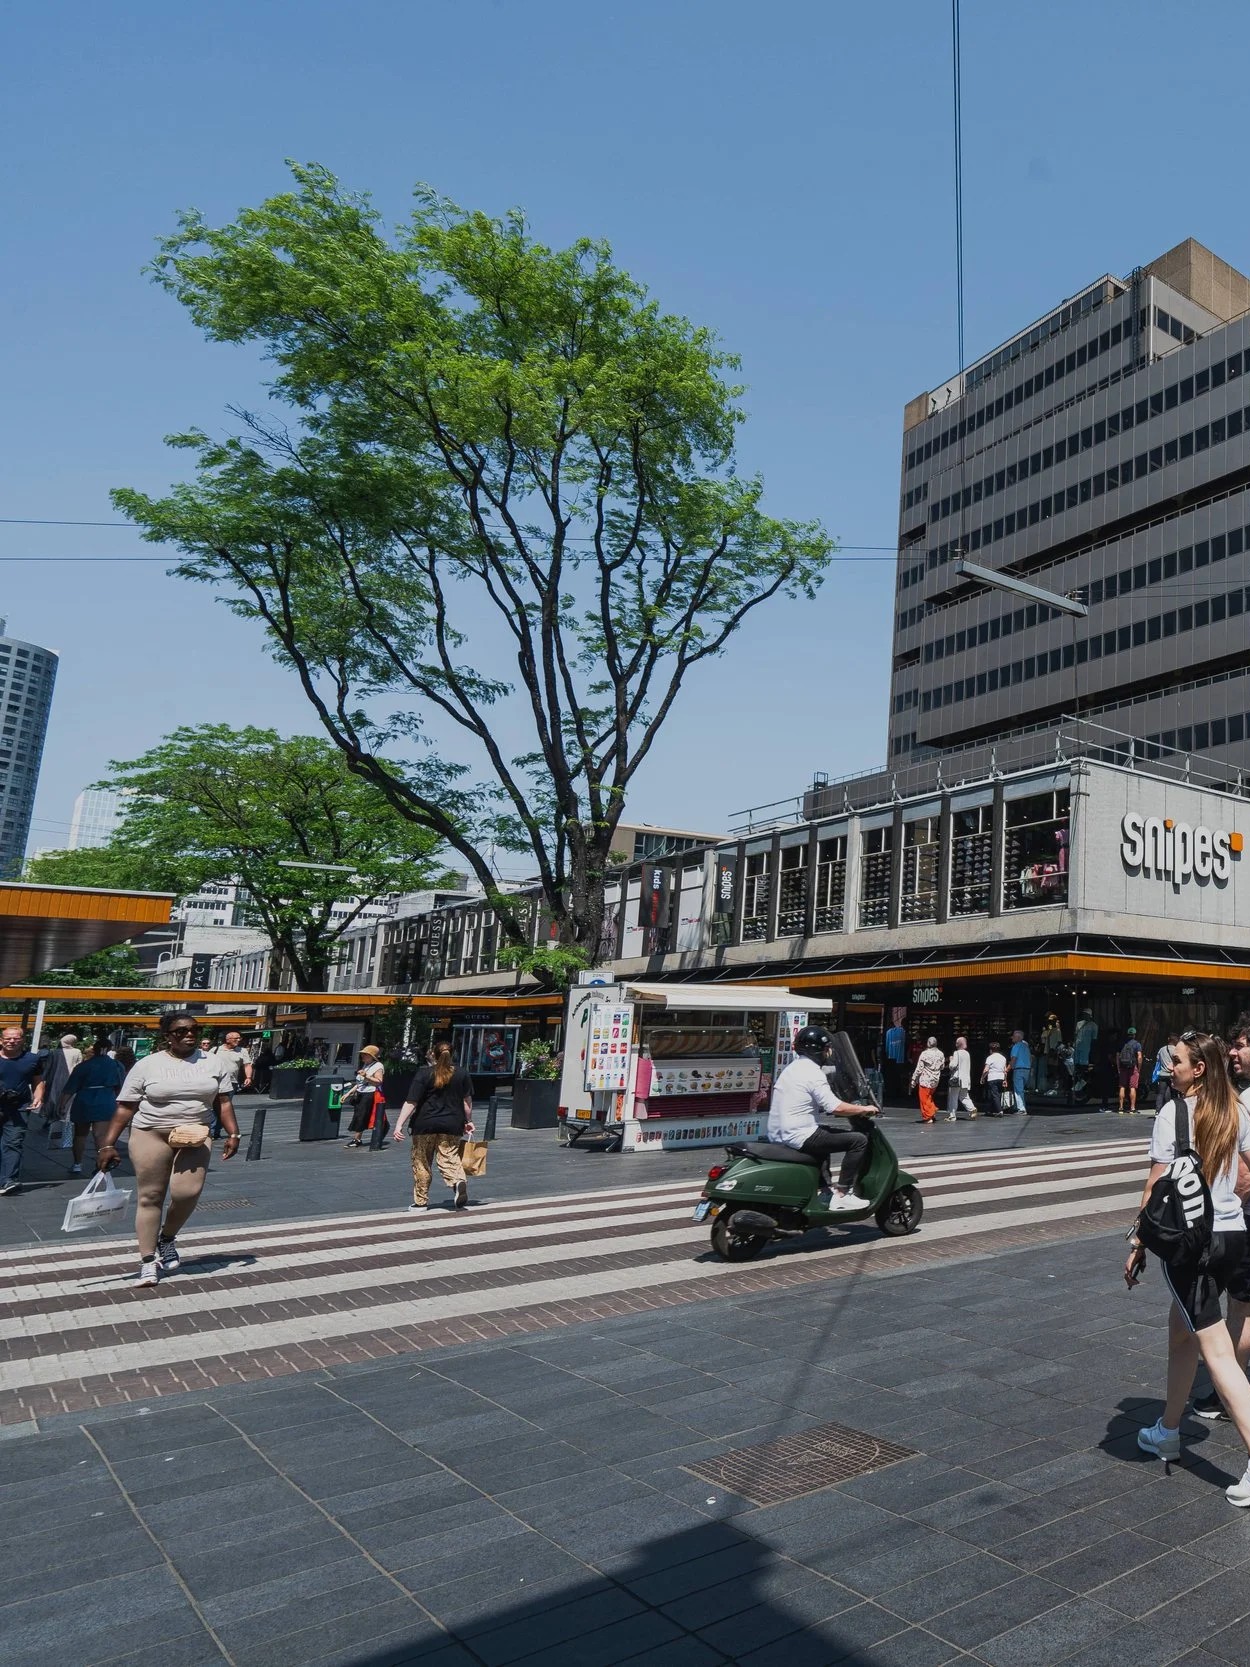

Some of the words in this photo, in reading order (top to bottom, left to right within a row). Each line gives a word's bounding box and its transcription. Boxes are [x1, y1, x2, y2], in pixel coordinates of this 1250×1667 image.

[1121, 812, 1232, 884] snipes
[653, 869, 662, 890] kids
[720, 870, 732, 900] snipes
[518, 899, 529, 932] UESS
[430, 918, 442, 957] GUESS
[912, 987, 939, 1006] snipes
